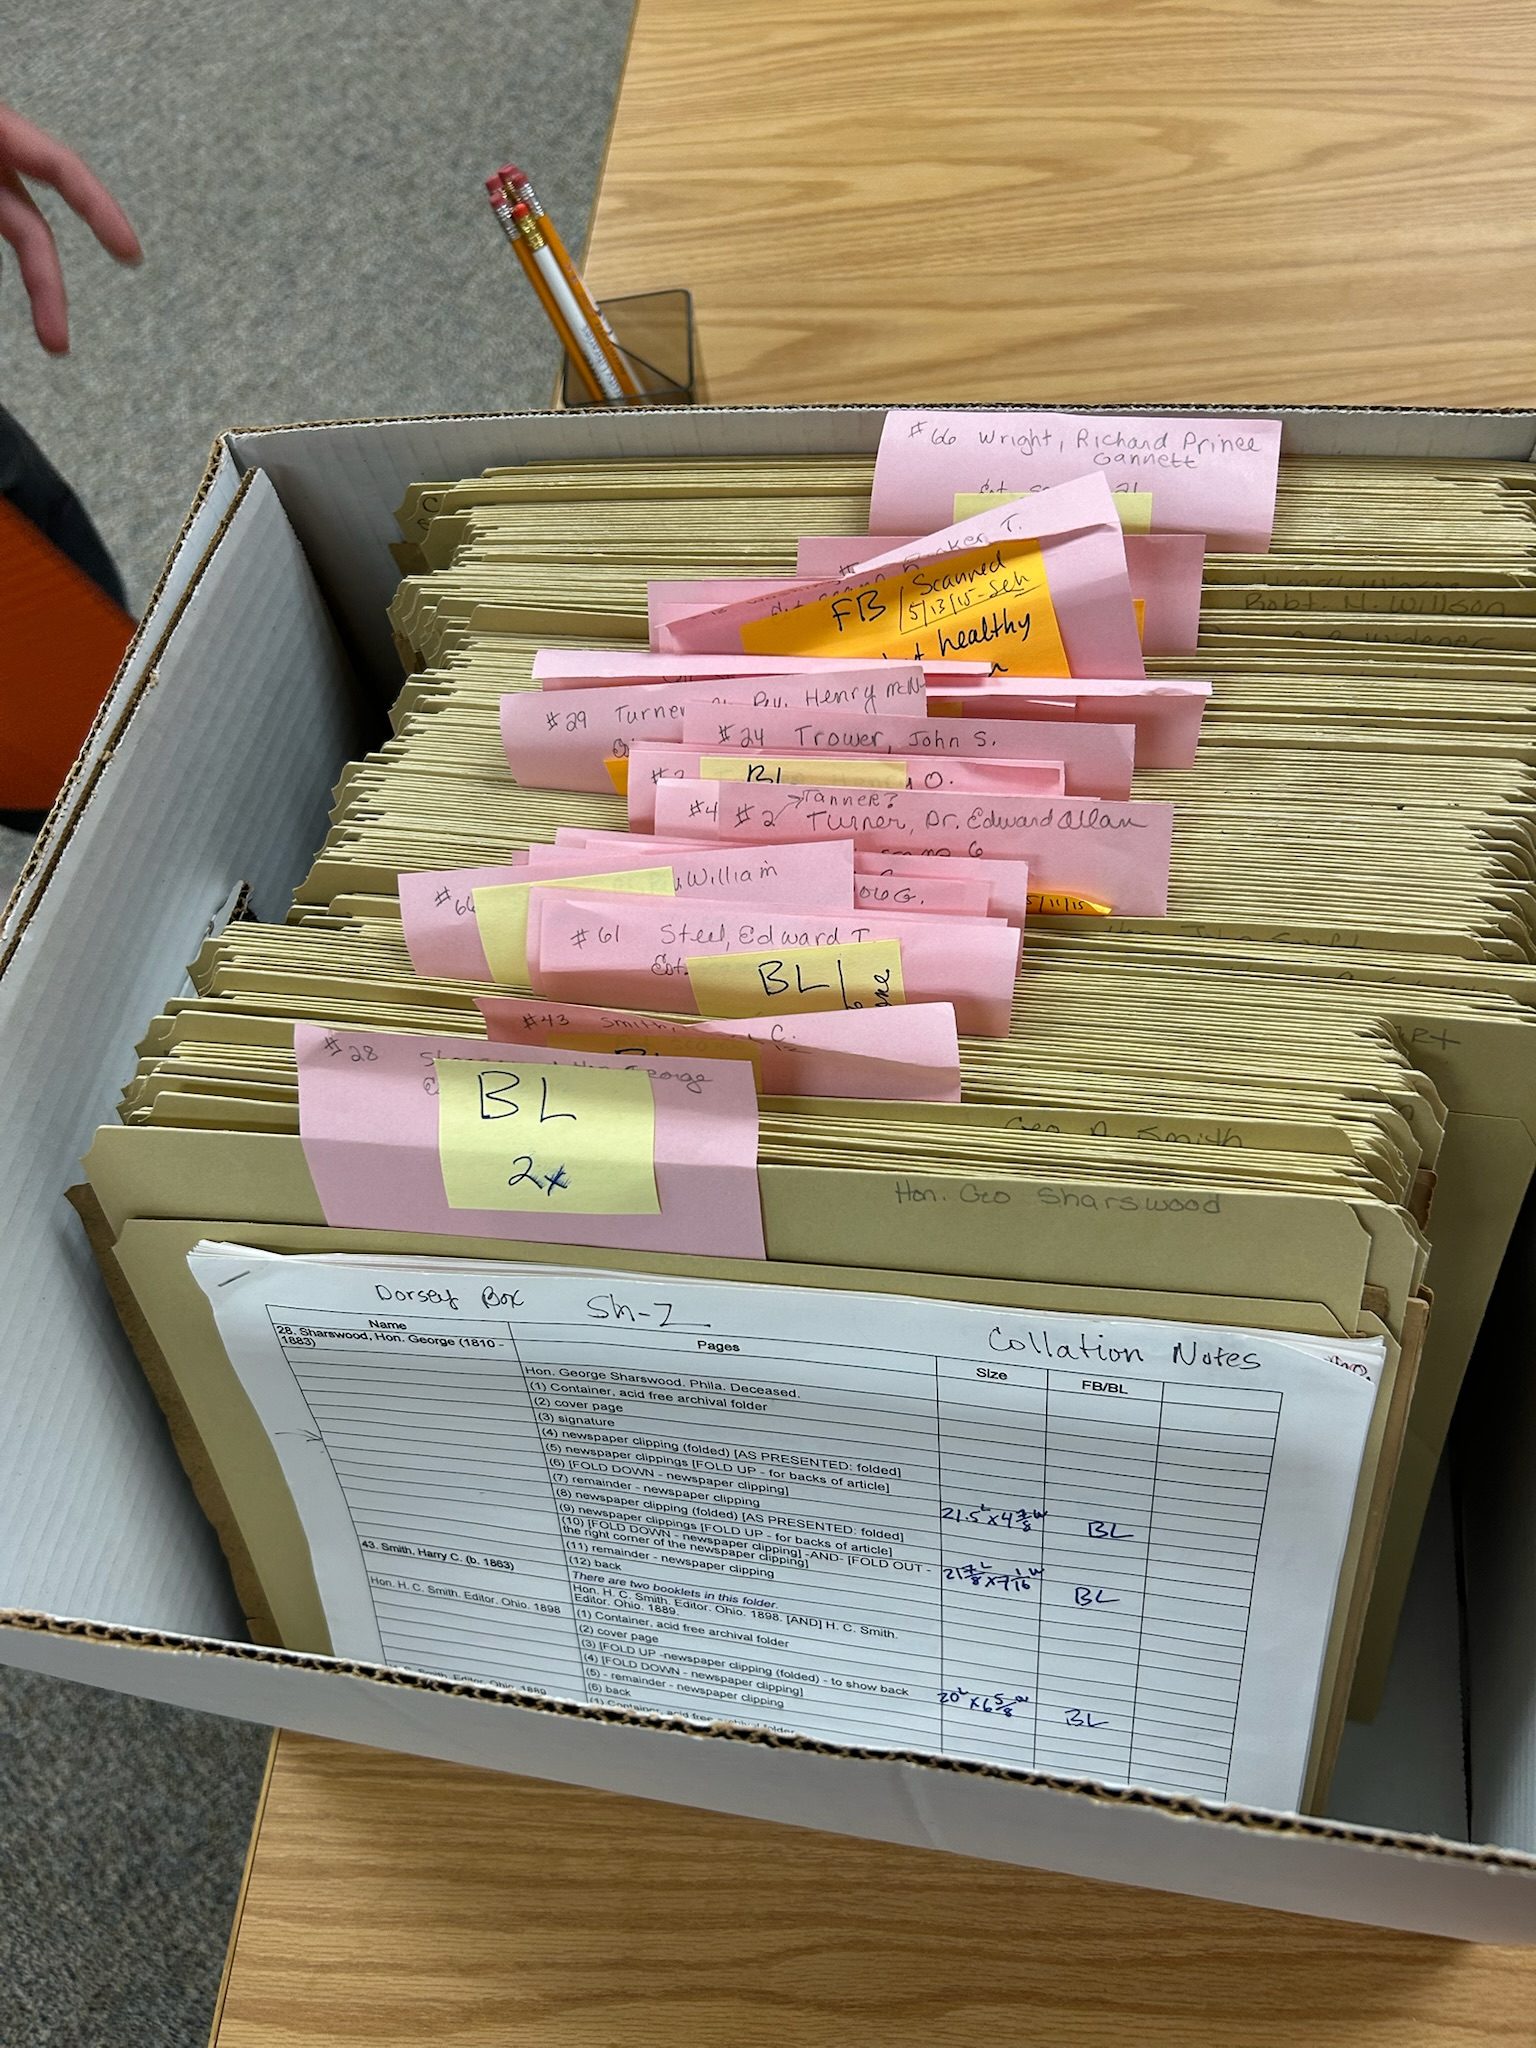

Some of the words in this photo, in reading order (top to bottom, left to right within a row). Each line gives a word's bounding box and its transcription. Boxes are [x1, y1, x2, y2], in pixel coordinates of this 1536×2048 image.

[979, 429, 1063, 456] Wright,
[1077, 428, 1168, 451] Richard
[1093, 451, 1198, 469] Gannett
[911, 551, 1011, 597] Scanned
[938, 607, 1031, 657] healthy
[805, 684, 878, 714] Henry
[718, 725, 767, 748] #24
[795, 724, 893, 754] Trower,
[909, 731, 960, 747] John
[976, 731, 998, 748] S.
[925, 810, 960, 831] Dr.
[966, 808, 1054, 831] Edward
[687, 861, 778, 888] William
[570, 925, 620, 950] #61
[738, 924, 841, 947] Edward
[1036, 1186, 1221, 1215] Sharswood
[374, 1284, 460, 1310] Dorsey
[480, 1285, 525, 1309] Box
[276, 1324, 297, 1336] 28.
[299, 1326, 374, 1342] Sharswood,
[376, 1331, 406, 1343] Hon.
[408, 1334, 456, 1347] George
[459, 1337, 496, 1349] (1810
[368, 1319, 408, 1331] Name
[280, 1334, 317, 1348] 1883)
[697, 1340, 741, 1353] Pages
[988, 1326, 1144, 1363] Collation
[1172, 1341, 1262, 1370] Notes
[525, 1366, 555, 1376] Hon.
[559, 1368, 608, 1381] George
[975, 1366, 1009, 1381] Size
[530, 1381, 546, 1392] (1)
[620, 1389, 646, 1399] acid
[648, 1391, 674, 1402] free
[677, 1394, 727, 1407] archival
[731, 1399, 768, 1411] folder
[1080, 1379, 1130, 1395] FB/BL
[534, 1397, 551, 1408] (2)
[554, 1400, 588, 1409] cover
[592, 1403, 623, 1413] page
[538, 1412, 555, 1422] (3)
[558, 1415, 615, 1427] signature
[542, 1428, 558, 1438] (4)
[562, 1431, 628, 1444] newspaper
[632, 1437, 679, 1452] clipping
[683, 1442, 730, 1457] (folded)
[734, 1449, 757, 1460] [AS
[761, 1452, 853, 1470] PRESENTED:
[857, 1463, 902, 1478] folded]
[545, 1442, 562, 1453] (5)
[566, 1445, 632, 1459] newspaper
[635, 1452, 688, 1467] clippings
[692, 1459, 733, 1471] [FOLD
[737, 1463, 756, 1474] UP
[769, 1470, 784, 1479] for
[789, 1472, 827, 1484] backs
[831, 1477, 844, 1486] of
[847, 1480, 890, 1494] article]
[549, 1458, 565, 1469] (6)
[569, 1460, 608, 1471] [FOLD
[611, 1465, 655, 1477] DOWN
[667, 1472, 733, 1489] newspaper
[737, 1481, 789, 1496] clipping]
[552, 1473, 569, 1484] (7)
[572, 1476, 632, 1490] remainder
[644, 1484, 710, 1501] newspaper
[713, 1493, 760, 1508] clipping
[1088, 1521, 1135, 1539] BL
[418, 1547, 447, 1561] Harry
[450, 1552, 463, 1562] C.
[484, 1558, 515, 1571] 1863)
[566, 1541, 588, 1551] (11)
[592, 1545, 649, 1559] remainder
[661, 1555, 726, 1571] newspaper
[729, 1565, 775, 1579] clipping
[569, 1556, 591, 1566] (12)
[595, 1560, 622, 1570] back
[370, 1576, 396, 1588] Hon.
[398, 1581, 410, 1590] H.
[412, 1583, 425, 1593] C.
[534, 1603, 561, 1614] 1898
[573, 1571, 605, 1582] There
[608, 1577, 626, 1586] are
[630, 1581, 650, 1590] two
[653, 1584, 701, 1598] booklets
[704, 1592, 715, 1600] in
[718, 1593, 738, 1604] this
[1073, 1586, 1121, 1606] BL
[573, 1584, 600, 1595] Hon.
[603, 1588, 616, 1597] H.
[619, 1591, 632, 1600] C.
[787, 1615, 822, 1630] [AND]
[826, 1622, 839, 1631] H.
[843, 1624, 856, 1633] C.
[579, 1625, 594, 1635] (2)
[597, 1628, 628, 1638] cover
[631, 1633, 659, 1644] page
[588, 1682, 602, 1693] (6)
[605, 1685, 631, 1697] back
